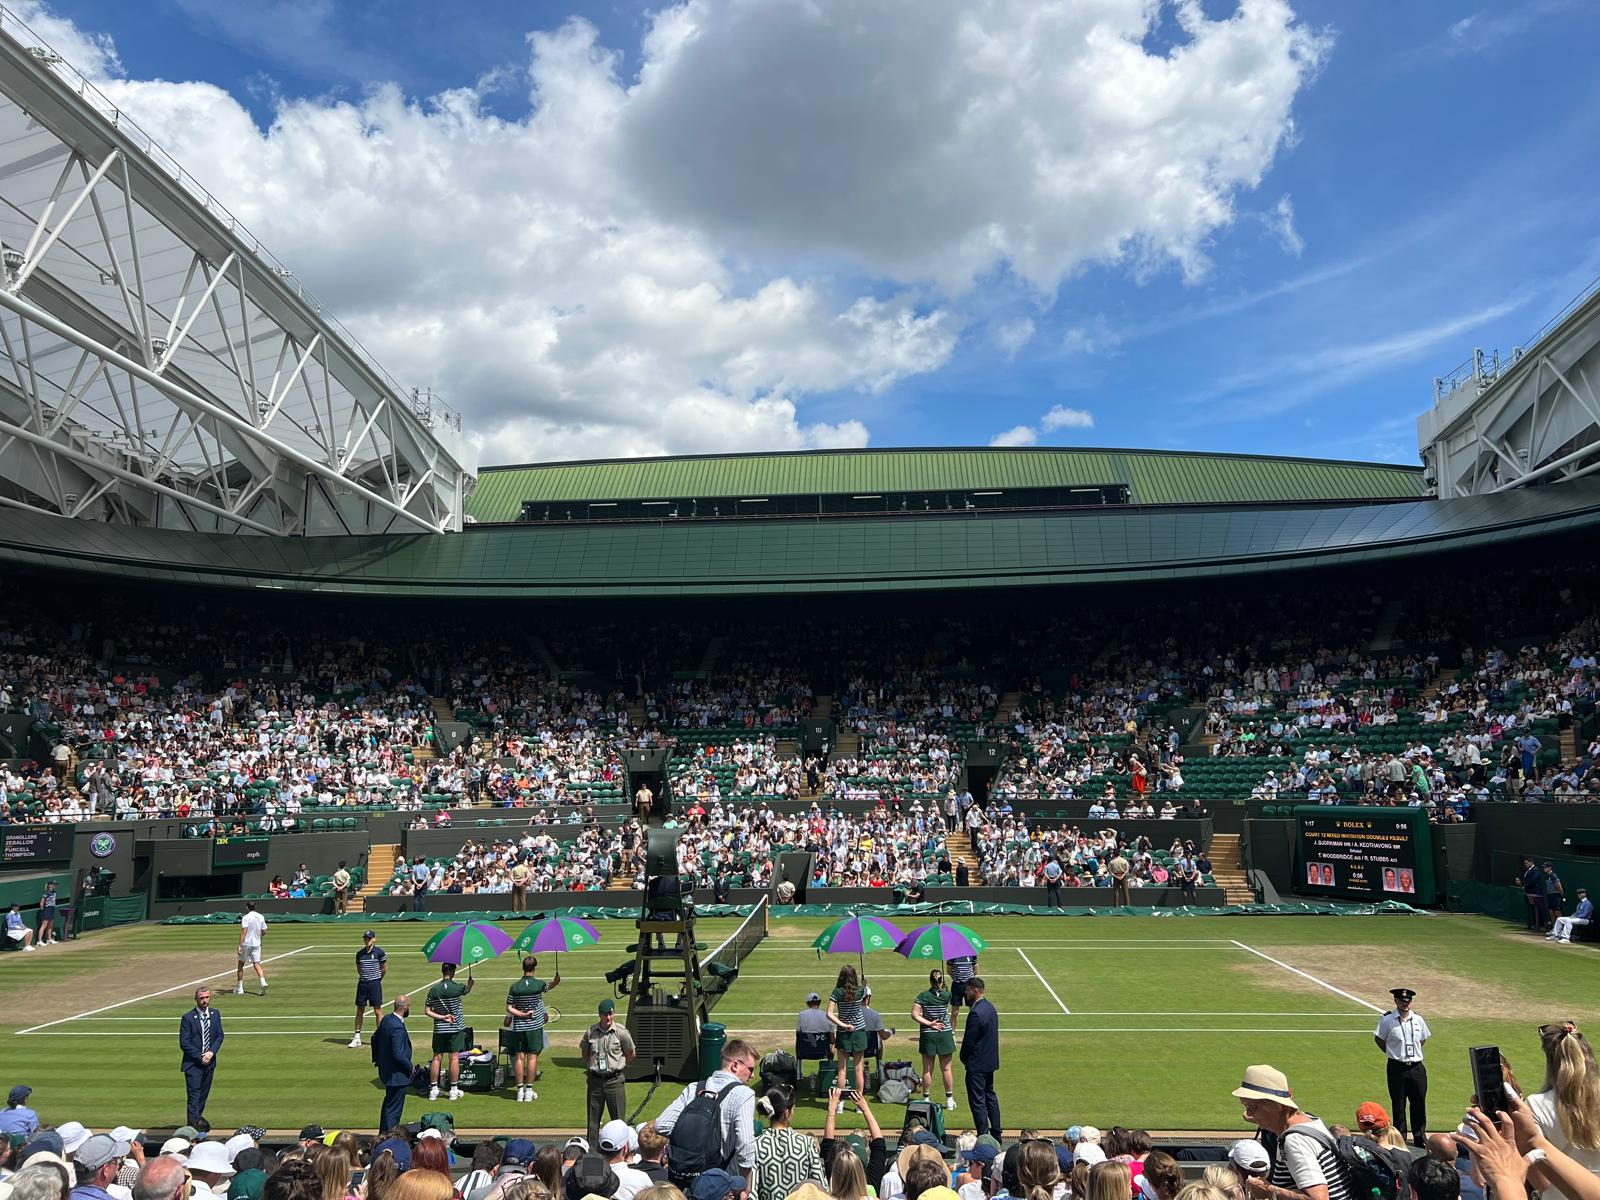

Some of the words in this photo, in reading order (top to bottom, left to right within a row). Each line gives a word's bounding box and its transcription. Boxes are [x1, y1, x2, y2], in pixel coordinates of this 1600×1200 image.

[6, 725, 13, 733] 4
[988, 748, 996, 756] 12
[640, 754, 645, 762] 8
[247, 851, 260, 859] mph
[1323, 853, 1354, 861] WOODBRIDGE
